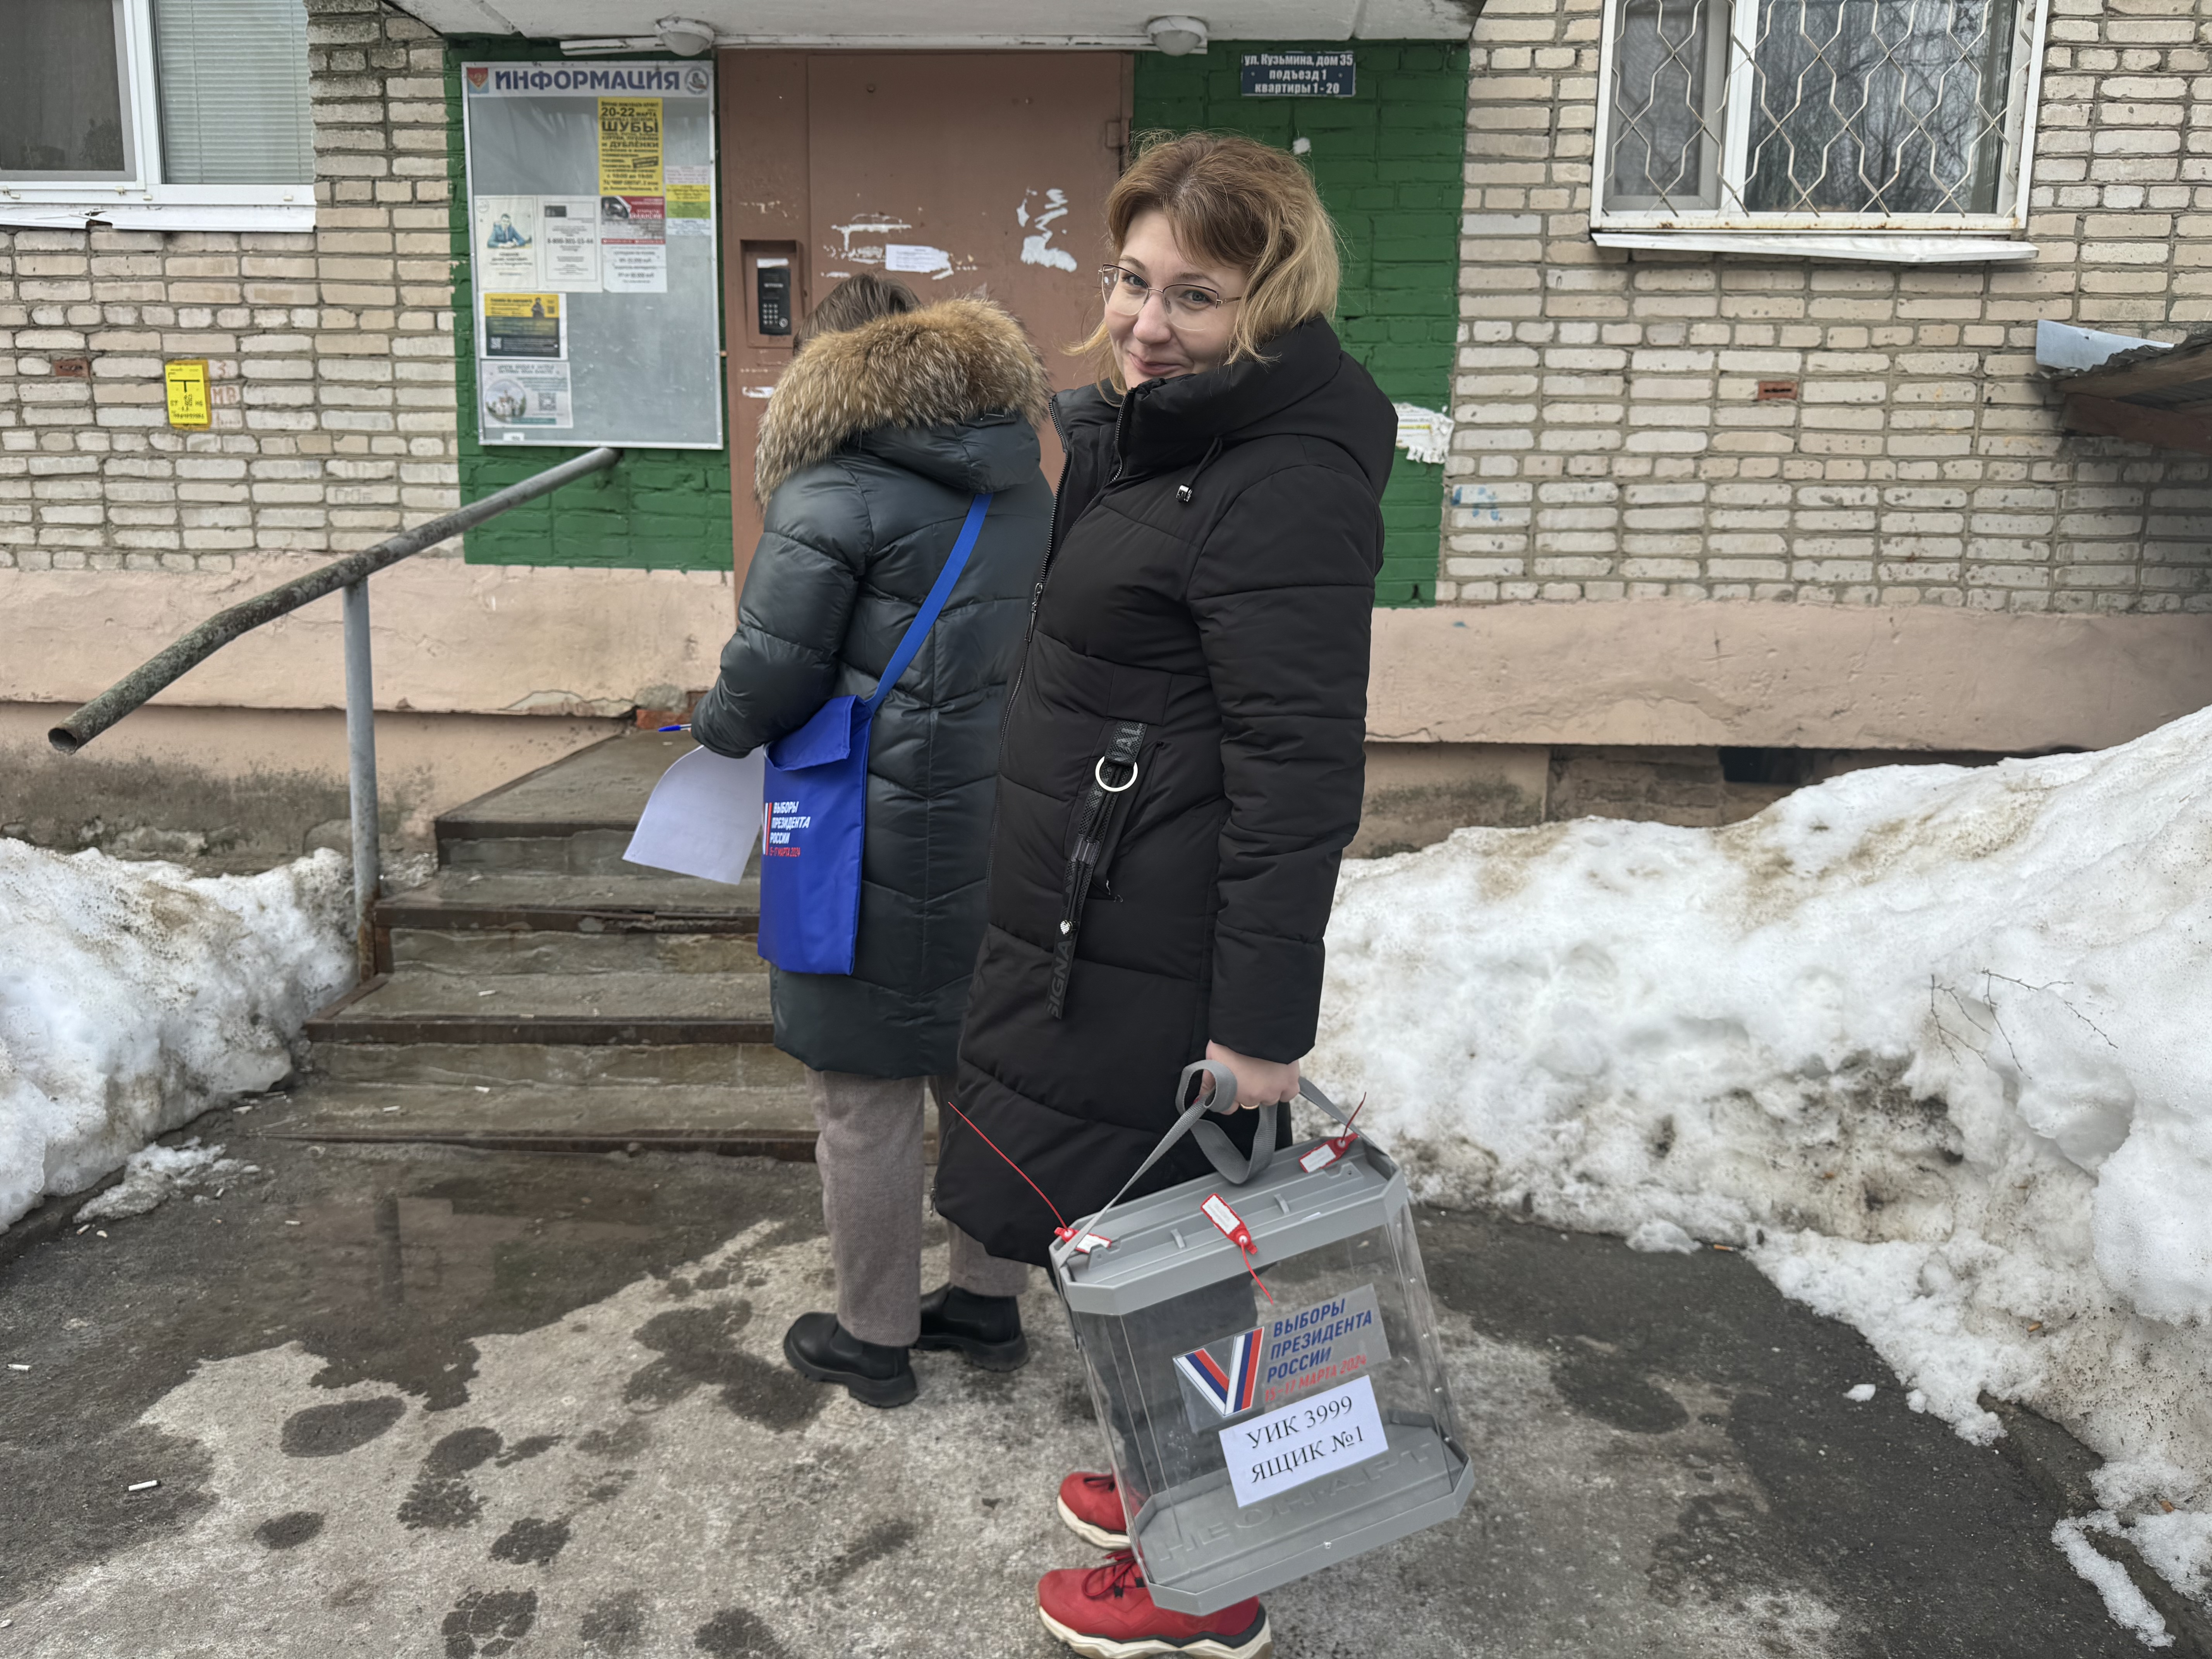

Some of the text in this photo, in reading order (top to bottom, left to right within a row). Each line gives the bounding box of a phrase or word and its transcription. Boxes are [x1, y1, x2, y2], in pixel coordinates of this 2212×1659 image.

[1244, 53, 1353, 67] ул. Кузьмина, дом 35
[495, 70, 680, 90] ИНФОРМАЦИЯ
[1269, 69, 1327, 81] подъезд 1
[1254, 83, 1311, 94] квартиры
[601, 107, 635, 116] 20-22
[602, 121, 658, 132] ШУБЫ
[773, 801, 799, 814] ВЫБОРЫ
[771, 816, 811, 830] ПРЕЗИДЕНТА
[769, 832, 790, 844] РОССИИ
[1273, 1298, 1345, 1338] ВЫБОРЫ
[1271, 1310, 1372, 1360] ПРЕЗИДЕНТА
[1267, 1346, 1332, 1383] РОССИИ
[1265, 1354, 1367, 1403] 15-17 МАРТА 2024
[1245, 1395, 1353, 1449] УИК 3999
[1251, 1440, 1326, 1484] ЯЩИК
